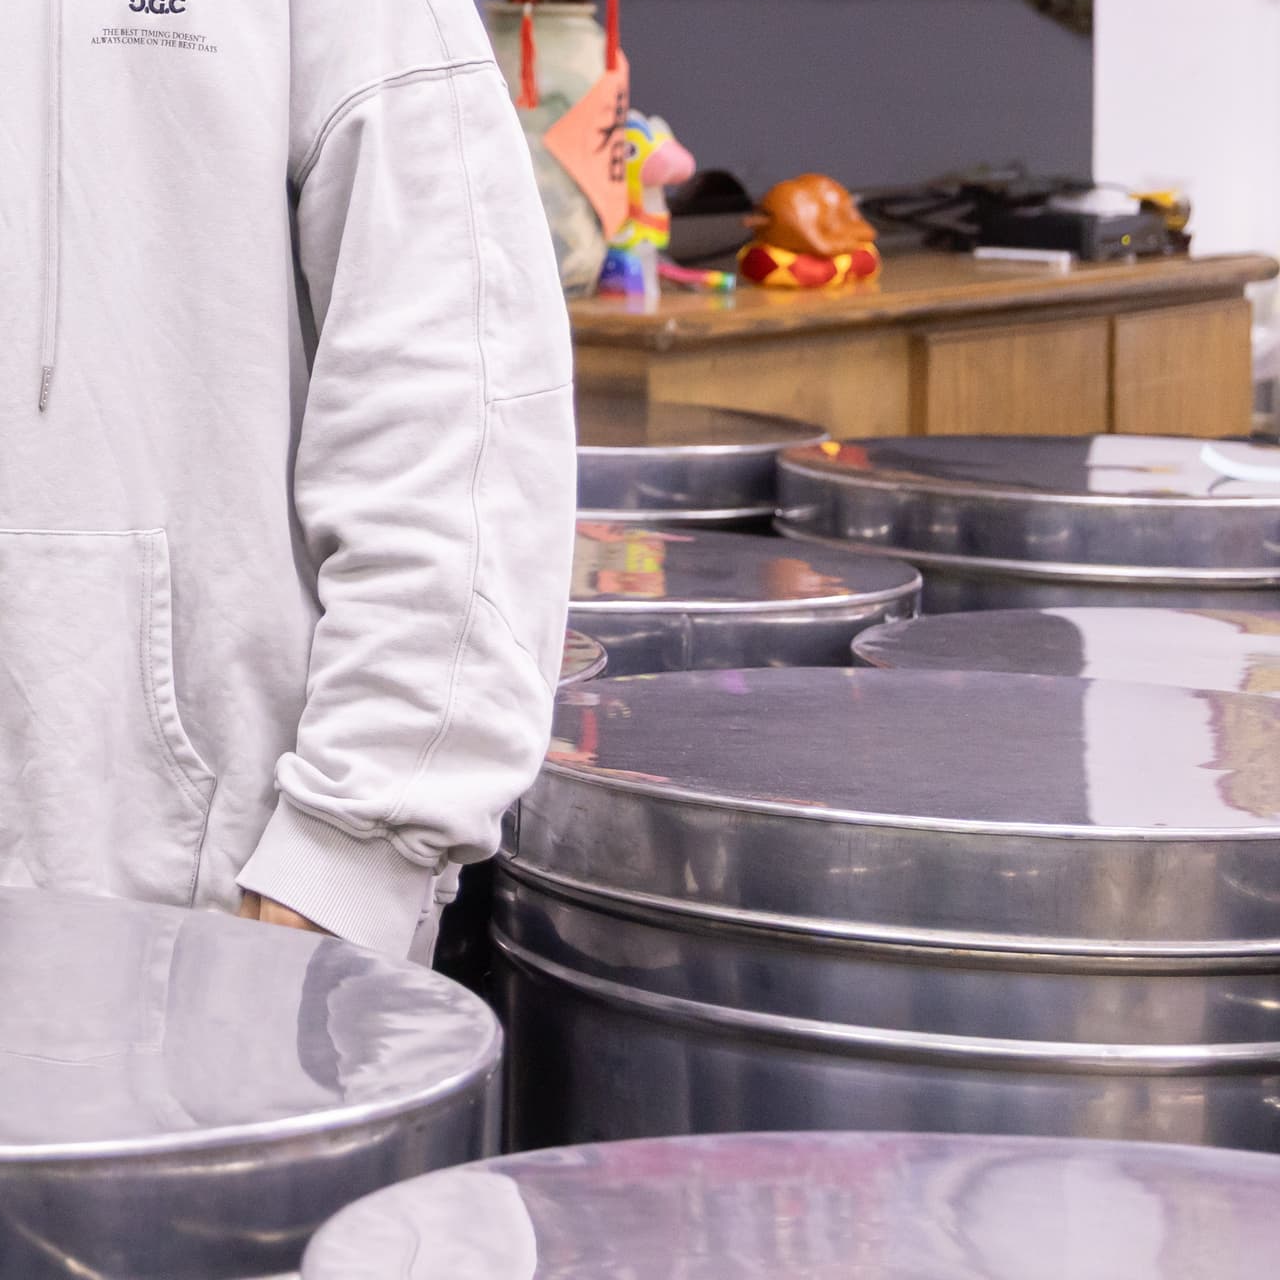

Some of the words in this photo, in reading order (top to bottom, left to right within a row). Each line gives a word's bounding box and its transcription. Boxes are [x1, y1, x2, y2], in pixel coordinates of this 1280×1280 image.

[102, 28, 120, 36] THE
[120, 28, 139, 37] BEST
[141, 29, 171, 39] TIMING
[172, 31, 207, 43] DOESN'T
[121, 36, 145, 45] COME
[146, 38, 159, 46] ON
[160, 39, 177, 48] THE
[178, 40, 196, 50] BEST
